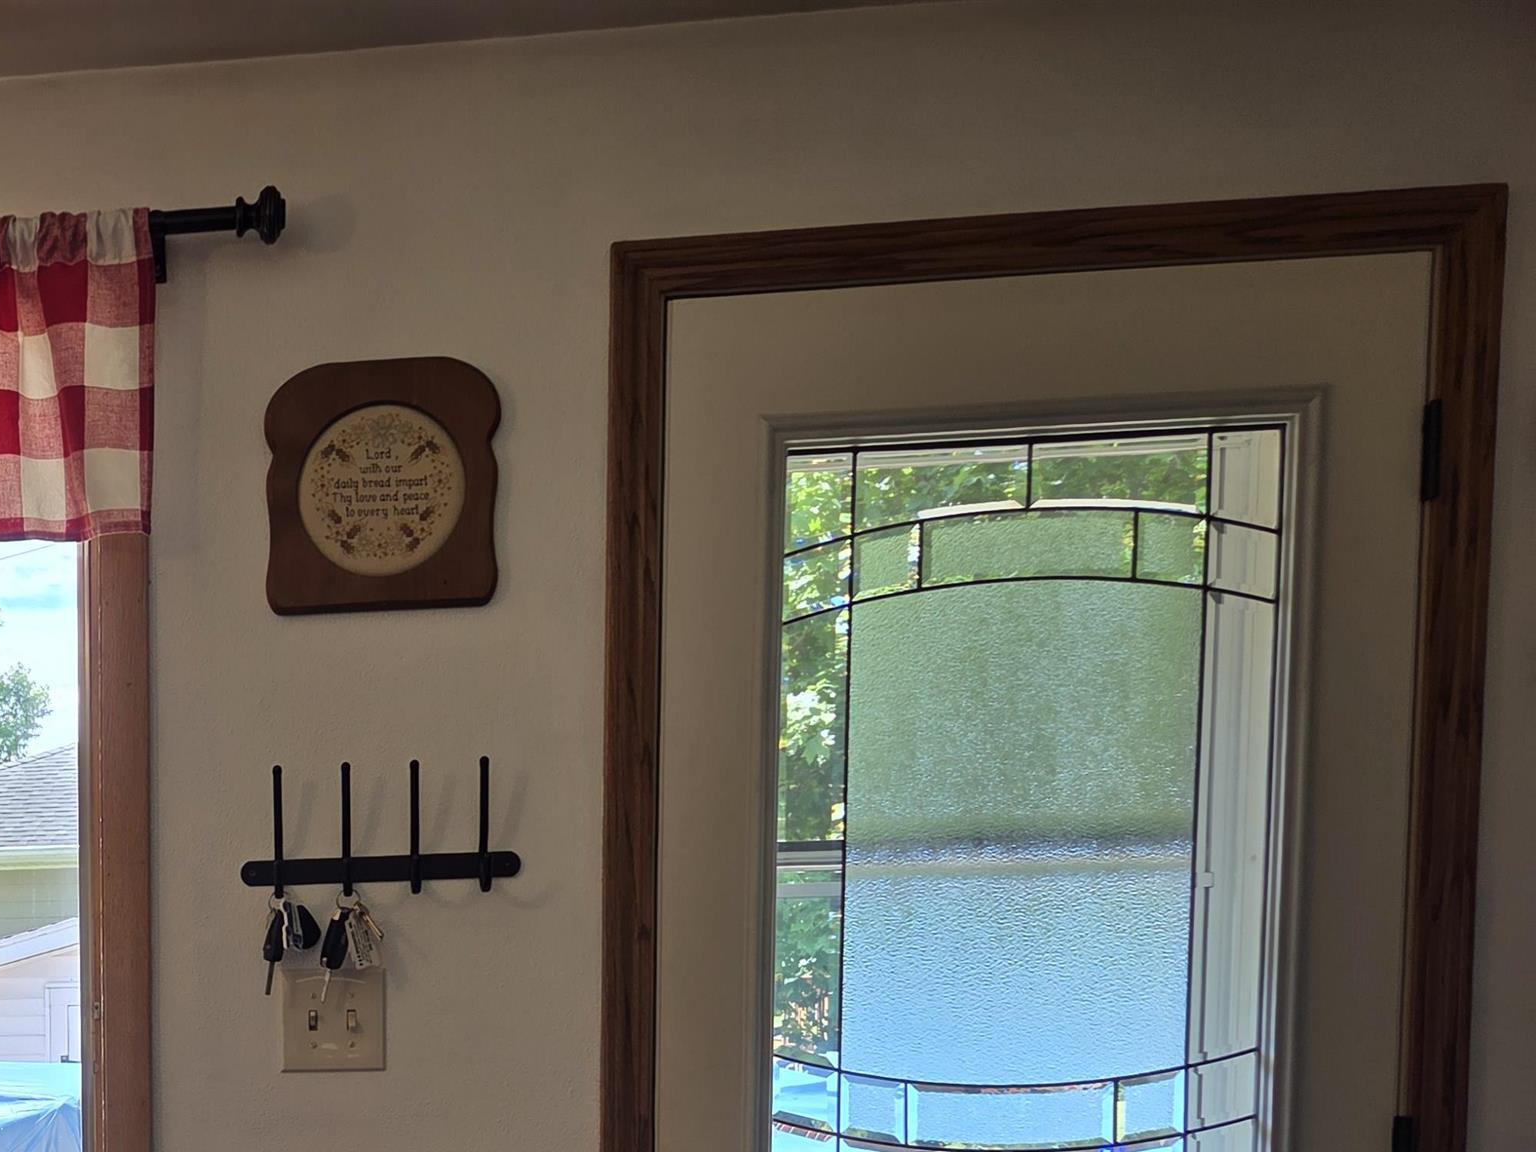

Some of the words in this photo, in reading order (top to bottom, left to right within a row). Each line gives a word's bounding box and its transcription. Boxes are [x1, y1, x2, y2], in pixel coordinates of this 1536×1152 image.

[359, 463, 382, 474] with
[385, 464, 402, 473] our
[334, 478, 359, 490] daily
[362, 477, 391, 488] bread
[395, 475, 428, 490] impart
[355, 489, 377, 502] love
[379, 490, 399, 502] and
[402, 491, 430, 504] peace
[345, 506, 355, 518] to
[357, 507, 388, 519] every
